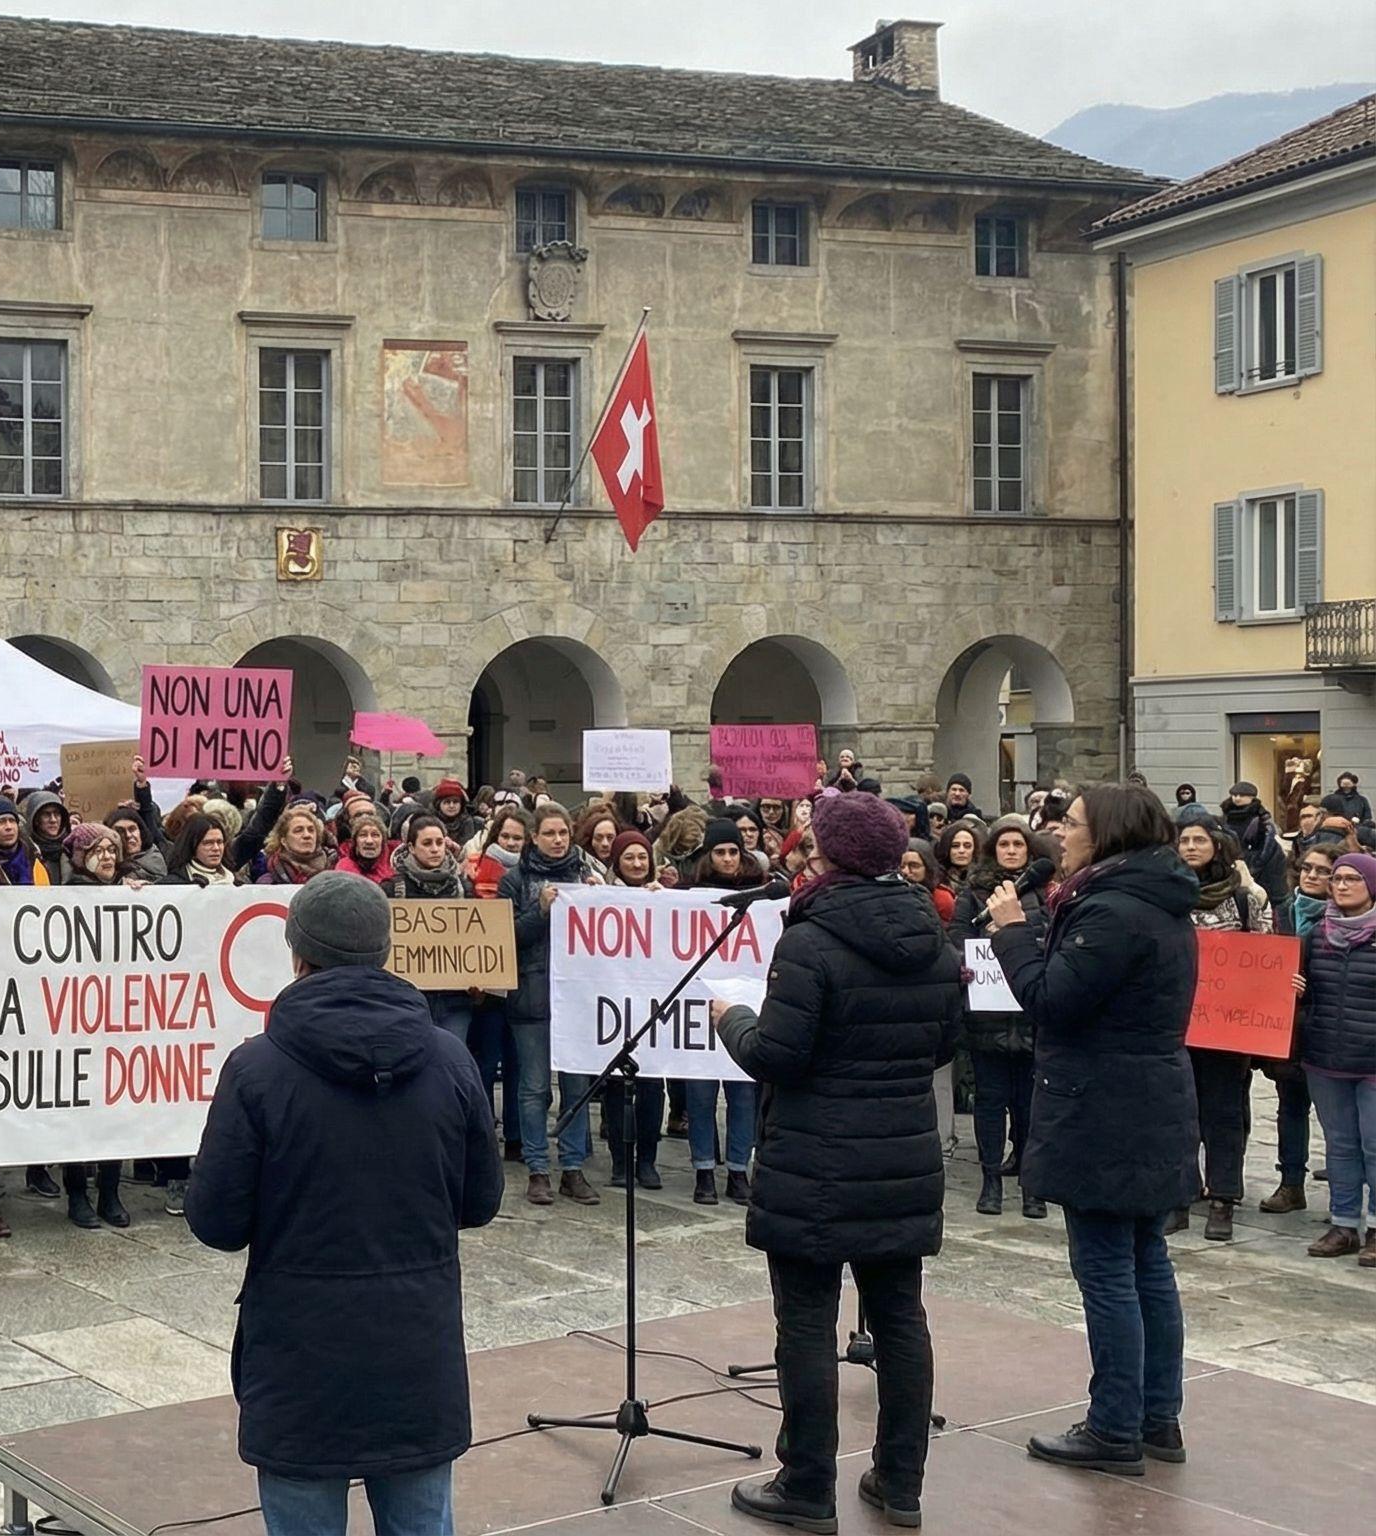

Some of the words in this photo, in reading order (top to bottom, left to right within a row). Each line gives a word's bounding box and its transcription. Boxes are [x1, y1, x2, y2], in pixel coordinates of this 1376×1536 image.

[150, 675, 211, 716] NON
[224, 677, 283, 719] UNA
[149, 726, 178, 768] DI
[194, 727, 282, 771] MENO
[13, 903, 183, 964] CONTRO
[392, 906, 486, 934] BASTA
[567, 906, 652, 959] NON
[671, 909, 762, 964] UNA
[392, 944, 505, 974] EMMINICIDI
[976, 970, 1005, 986] UNA
[40, 972, 217, 1035] VIOLENZA
[596, 995, 632, 1046] DI
[104, 1043, 216, 1106] DONNE
